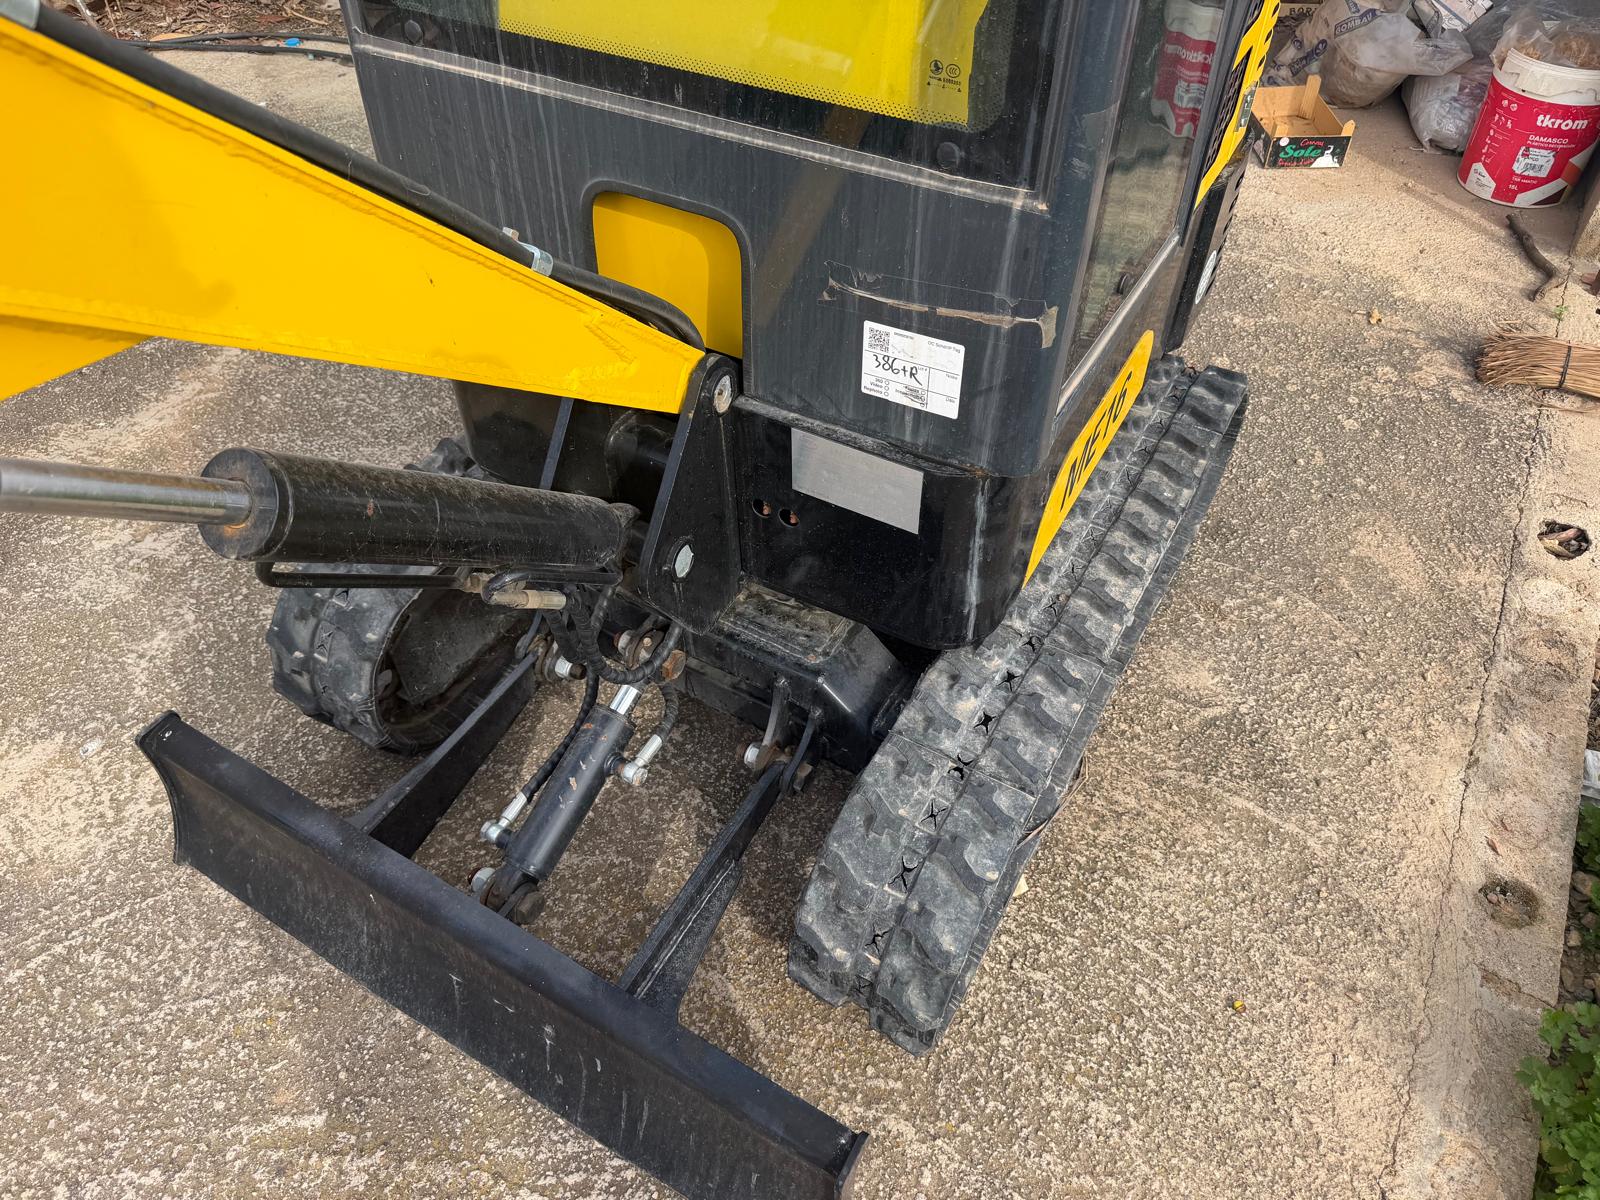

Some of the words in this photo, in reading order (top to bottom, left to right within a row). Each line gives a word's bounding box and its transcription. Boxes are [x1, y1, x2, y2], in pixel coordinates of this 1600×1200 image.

[1536, 114, 1589, 130] tkrom
[1528, 134, 1569, 144] DAMASCO
[1279, 145, 1322, 158] Sole
